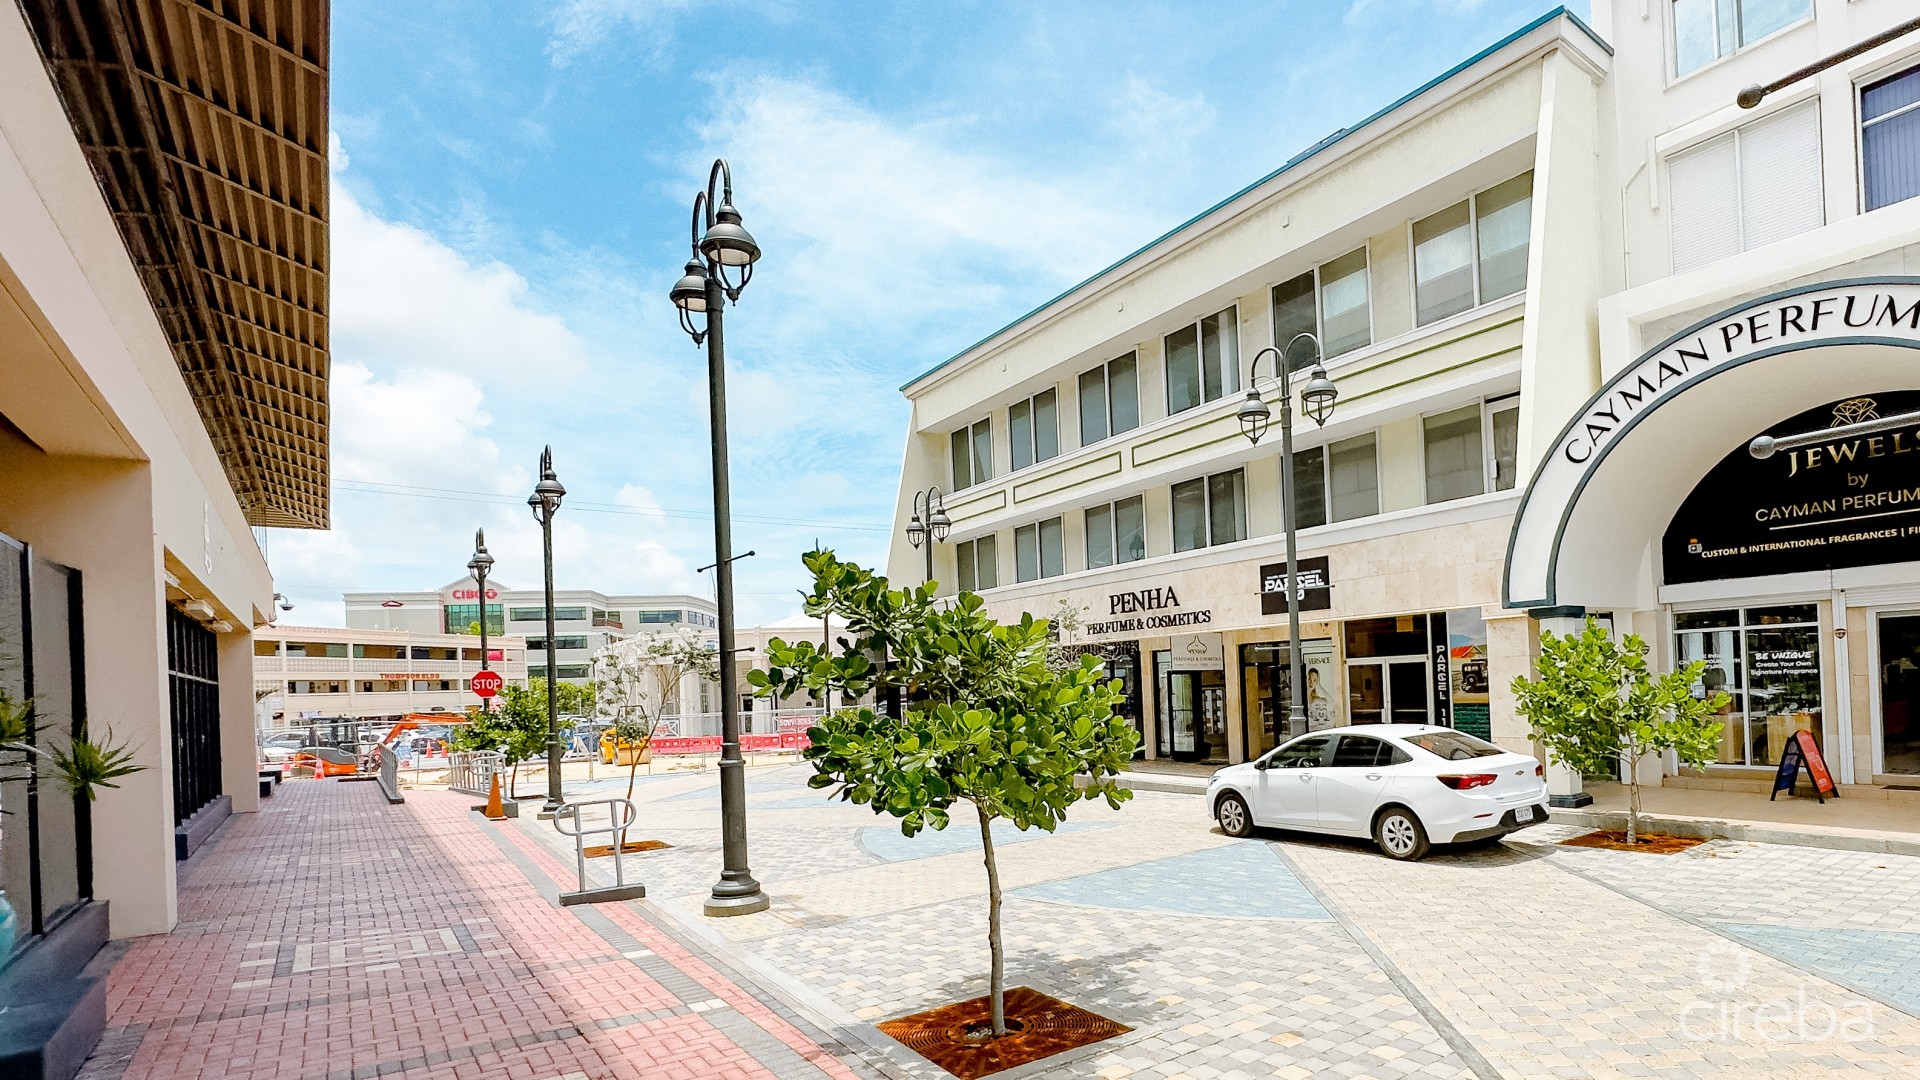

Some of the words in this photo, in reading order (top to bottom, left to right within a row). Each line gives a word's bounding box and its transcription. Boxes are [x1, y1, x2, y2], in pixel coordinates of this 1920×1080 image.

[1565, 337, 1709, 464] CAYMAN
[1848, 473, 1869, 488] by
[1755, 499, 1836, 522] CAYMAN
[1701, 547, 1738, 558] CUSTOM
[1740, 546, 1747, 554] &
[1749, 537, 1827, 553] INTERNATIONAL
[1828, 528, 1898, 544] FRAGRANCES
[1109, 585, 1180, 615] PENHA
[1086, 618, 1136, 635] PERFUME
[1136, 618, 1145, 630] &
[1146, 610, 1211, 629] COSMETICS
[1308, 656, 1330, 665] VERSACE
[1755, 652, 1769, 660] BE
[1771, 651, 1813, 660] UNIQUE
[1436, 645, 1447, 700] PARCEL
[1750, 668, 1783, 676] Signature
[473, 679, 501, 690] STOP
